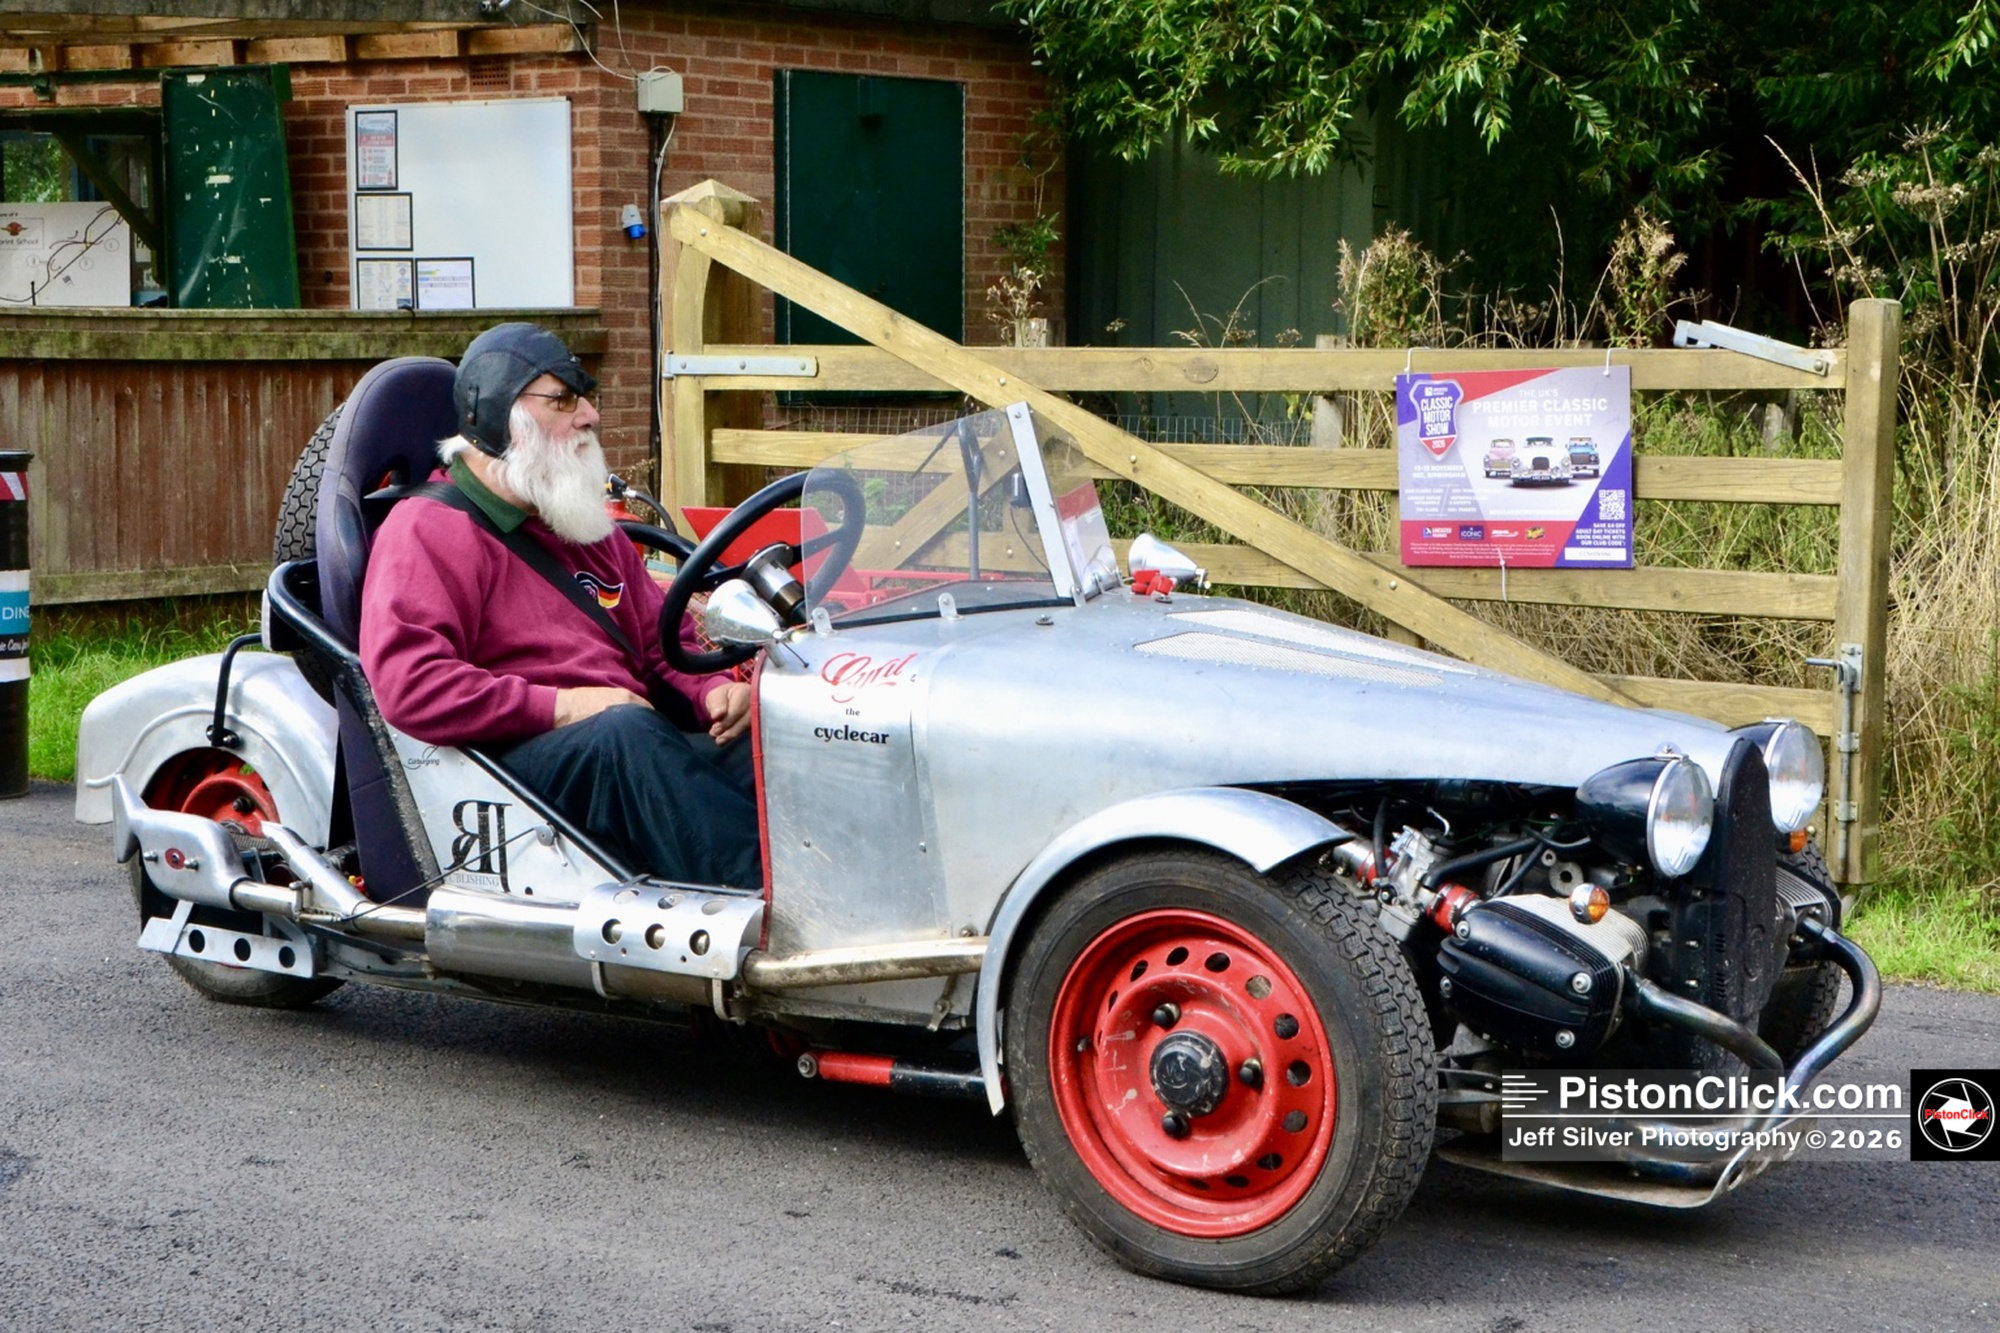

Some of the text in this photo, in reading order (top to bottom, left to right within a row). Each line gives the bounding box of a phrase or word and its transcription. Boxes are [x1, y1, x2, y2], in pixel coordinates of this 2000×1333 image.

[1421, 396, 1453, 412] CLASSIC
[1472, 398, 1608, 413] PREMIER CLASSIC
[1423, 409, 1451, 424] MOTOR
[1487, 413, 1593, 428] MOTOR EVENT
[1425, 421, 1449, 436] SHOW
[845, 707, 860, 717] the
[814, 724, 890, 745] cyclecar
